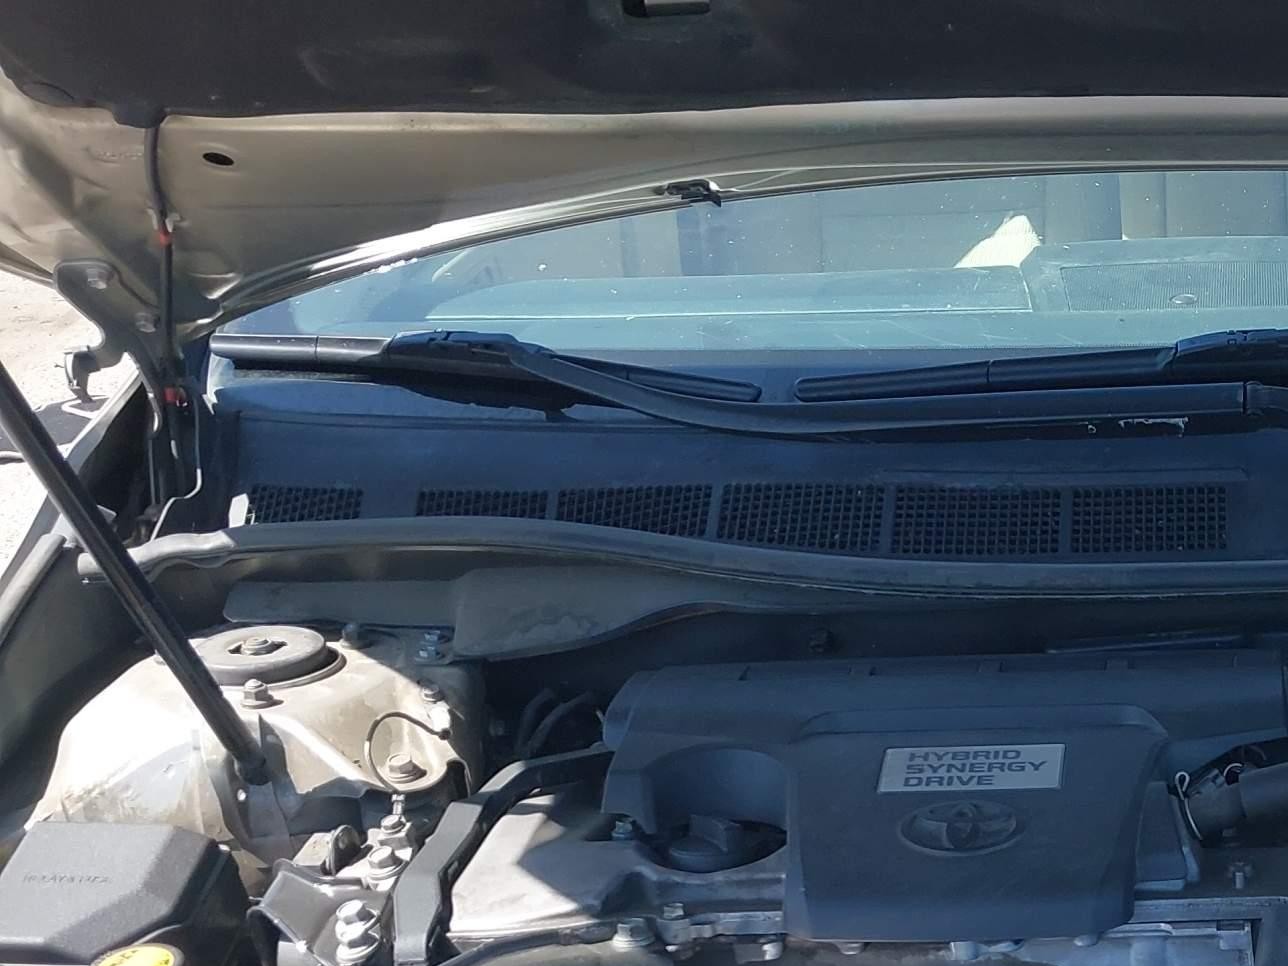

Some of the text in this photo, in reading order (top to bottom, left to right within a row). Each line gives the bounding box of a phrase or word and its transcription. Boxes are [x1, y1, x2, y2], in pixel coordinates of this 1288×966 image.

[908, 750, 1021, 762] HYBRID
[905, 761, 1047, 774] SYNERGY
[903, 775, 995, 787] DRIVE
